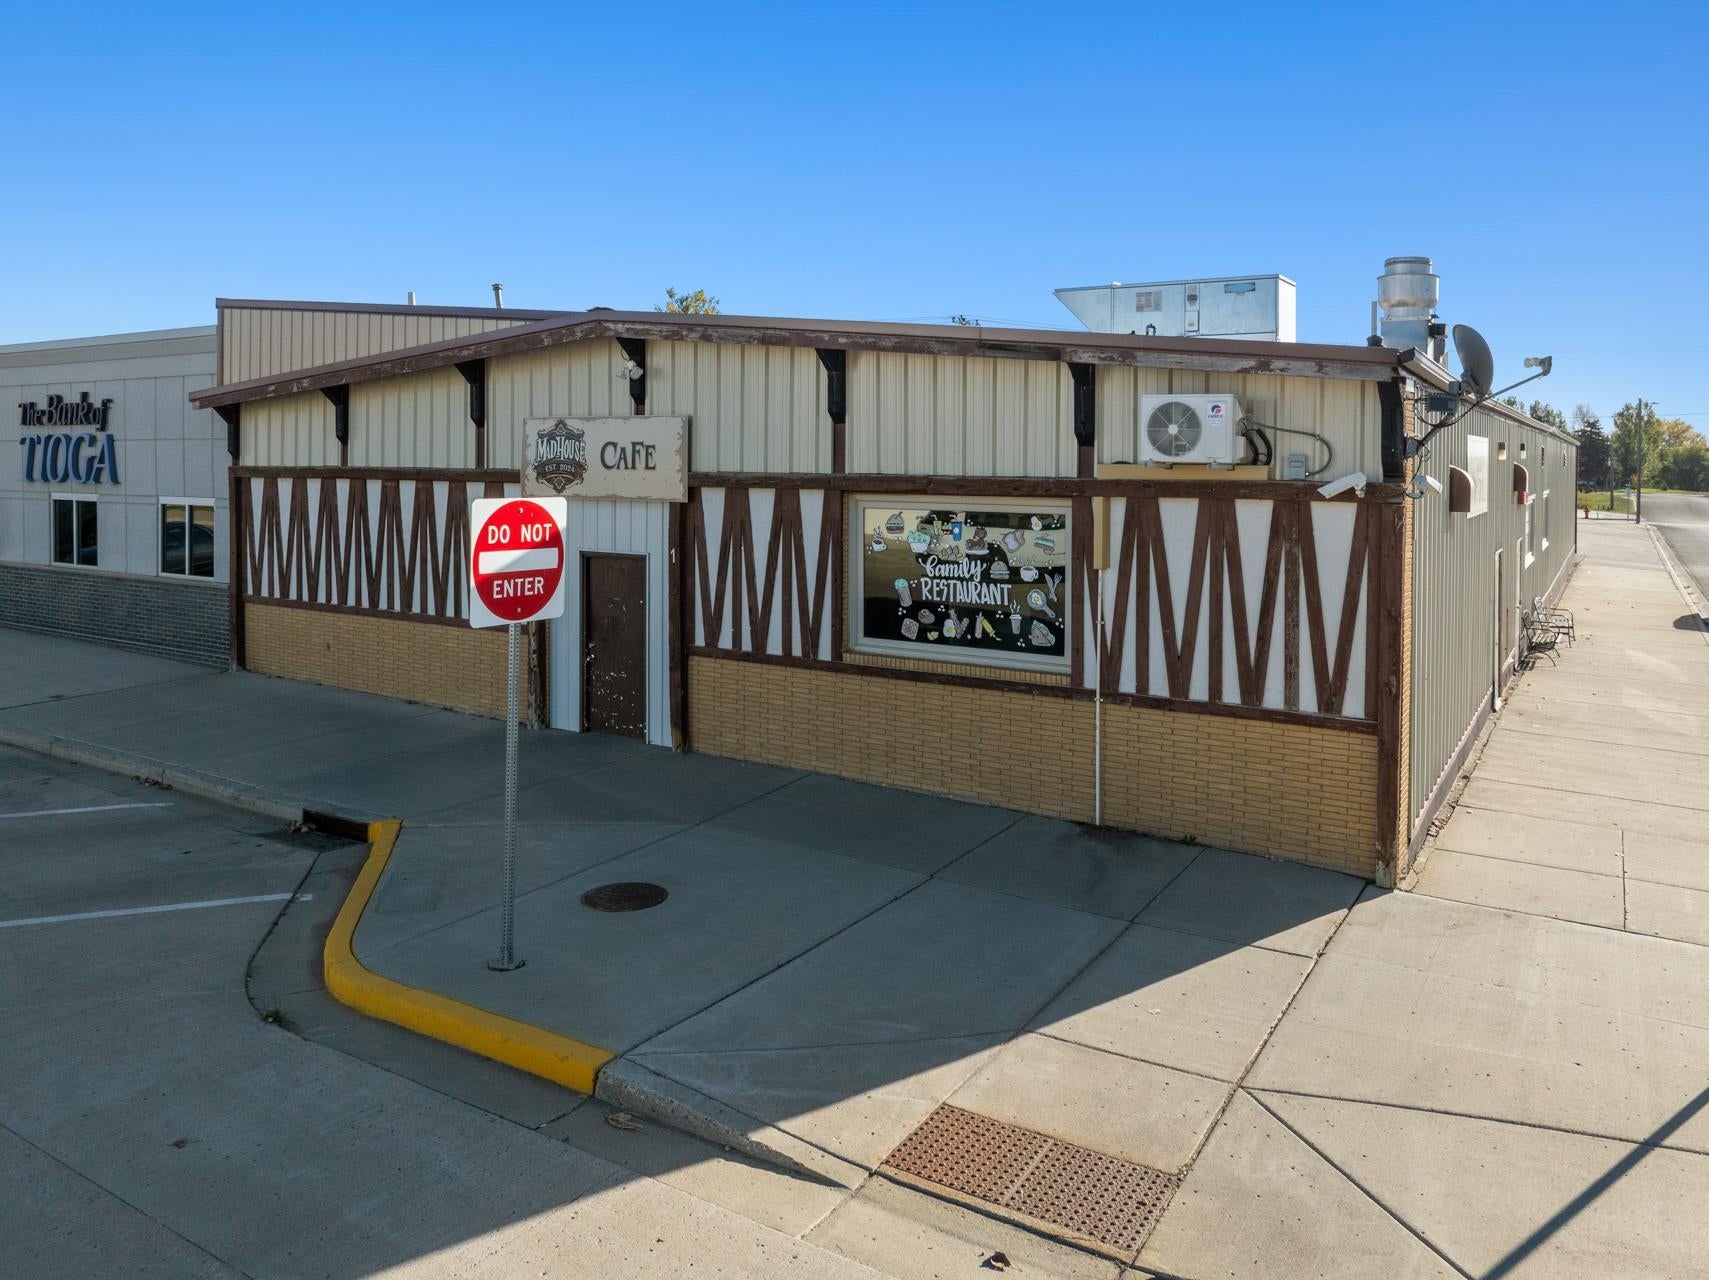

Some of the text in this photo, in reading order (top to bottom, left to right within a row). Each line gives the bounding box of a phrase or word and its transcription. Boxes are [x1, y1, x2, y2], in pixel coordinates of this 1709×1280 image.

[18, 391, 114, 432] The Bank of
[19, 432, 121, 484] TIOGA
[487, 523, 553, 545] DO NOT
[492, 576, 545, 599] ENTER
[920, 577, 1012, 606] RESTAURANT
